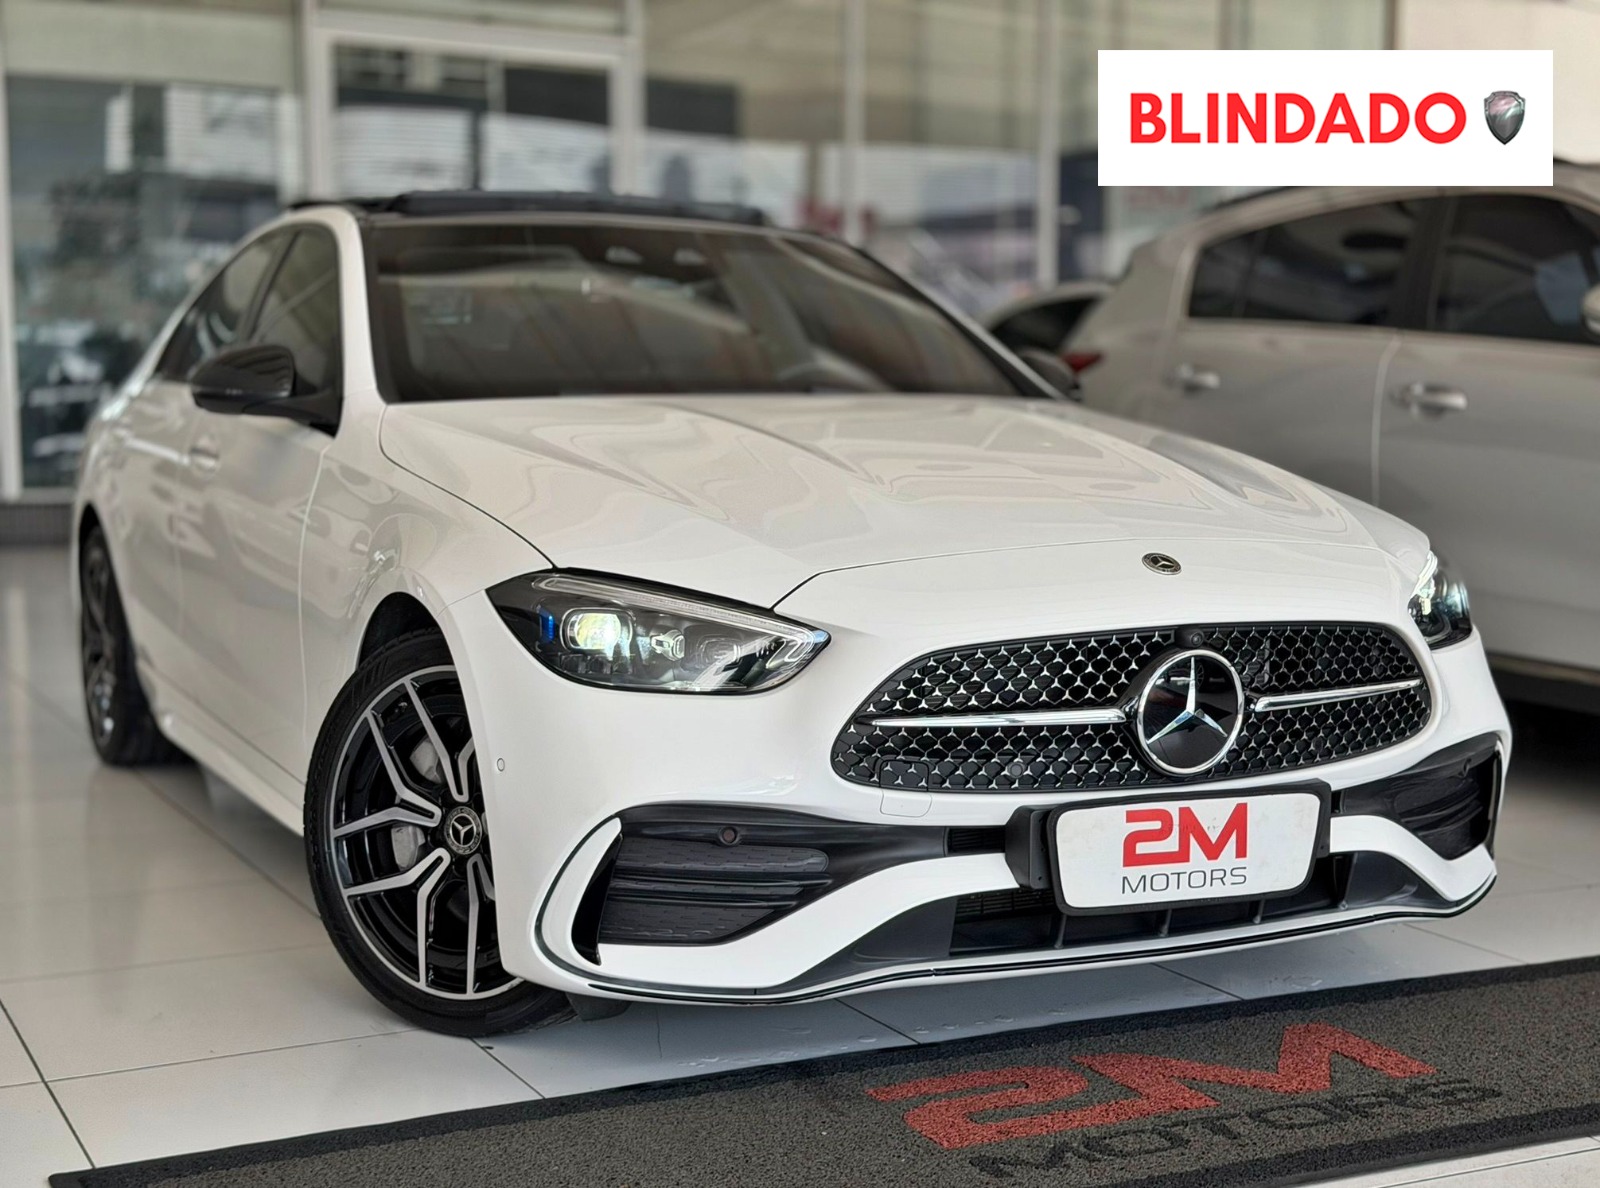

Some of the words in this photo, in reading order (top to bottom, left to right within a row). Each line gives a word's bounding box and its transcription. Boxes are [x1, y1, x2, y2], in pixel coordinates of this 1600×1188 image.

[1122, 802, 1248, 867] 2M
[1121, 867, 1247, 894] MOTORS
[866, 1022, 1438, 1150] 2M
[968, 1078, 1503, 1178] MOTORS
